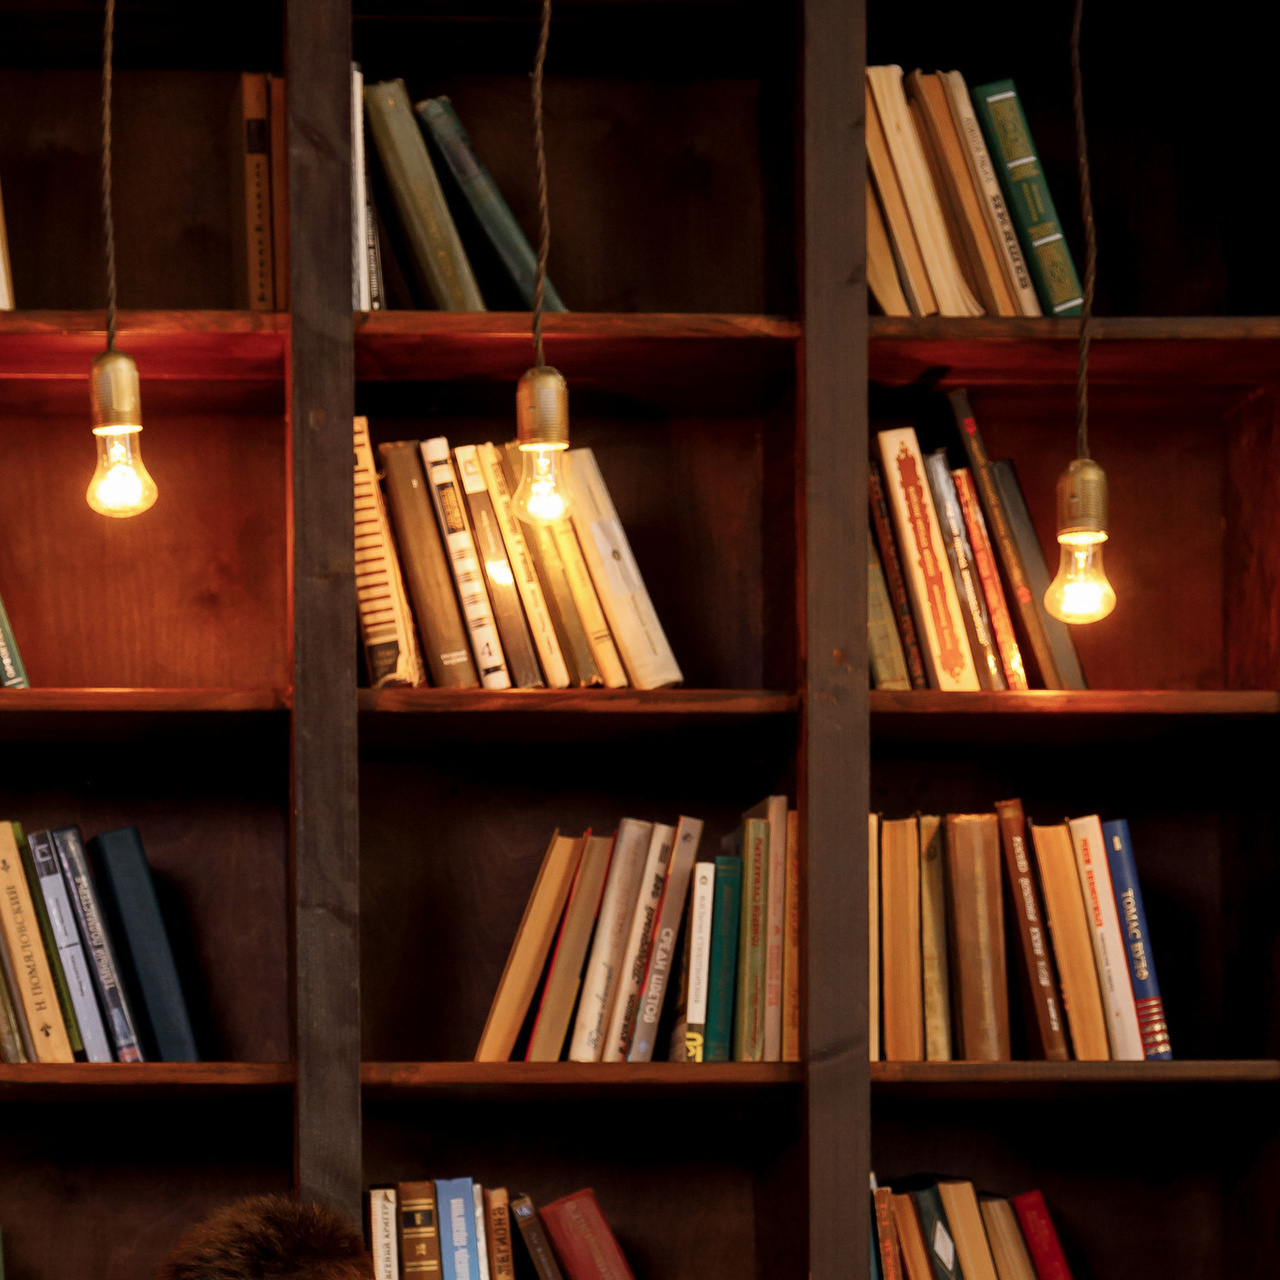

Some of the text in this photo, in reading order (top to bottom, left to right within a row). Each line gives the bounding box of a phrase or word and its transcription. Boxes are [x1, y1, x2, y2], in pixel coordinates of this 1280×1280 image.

[4, 884, 43, 996] ПОМЯЛОВСКИЙ
[1119, 887, 1149, 982] ТОМАС ВУЛФ
